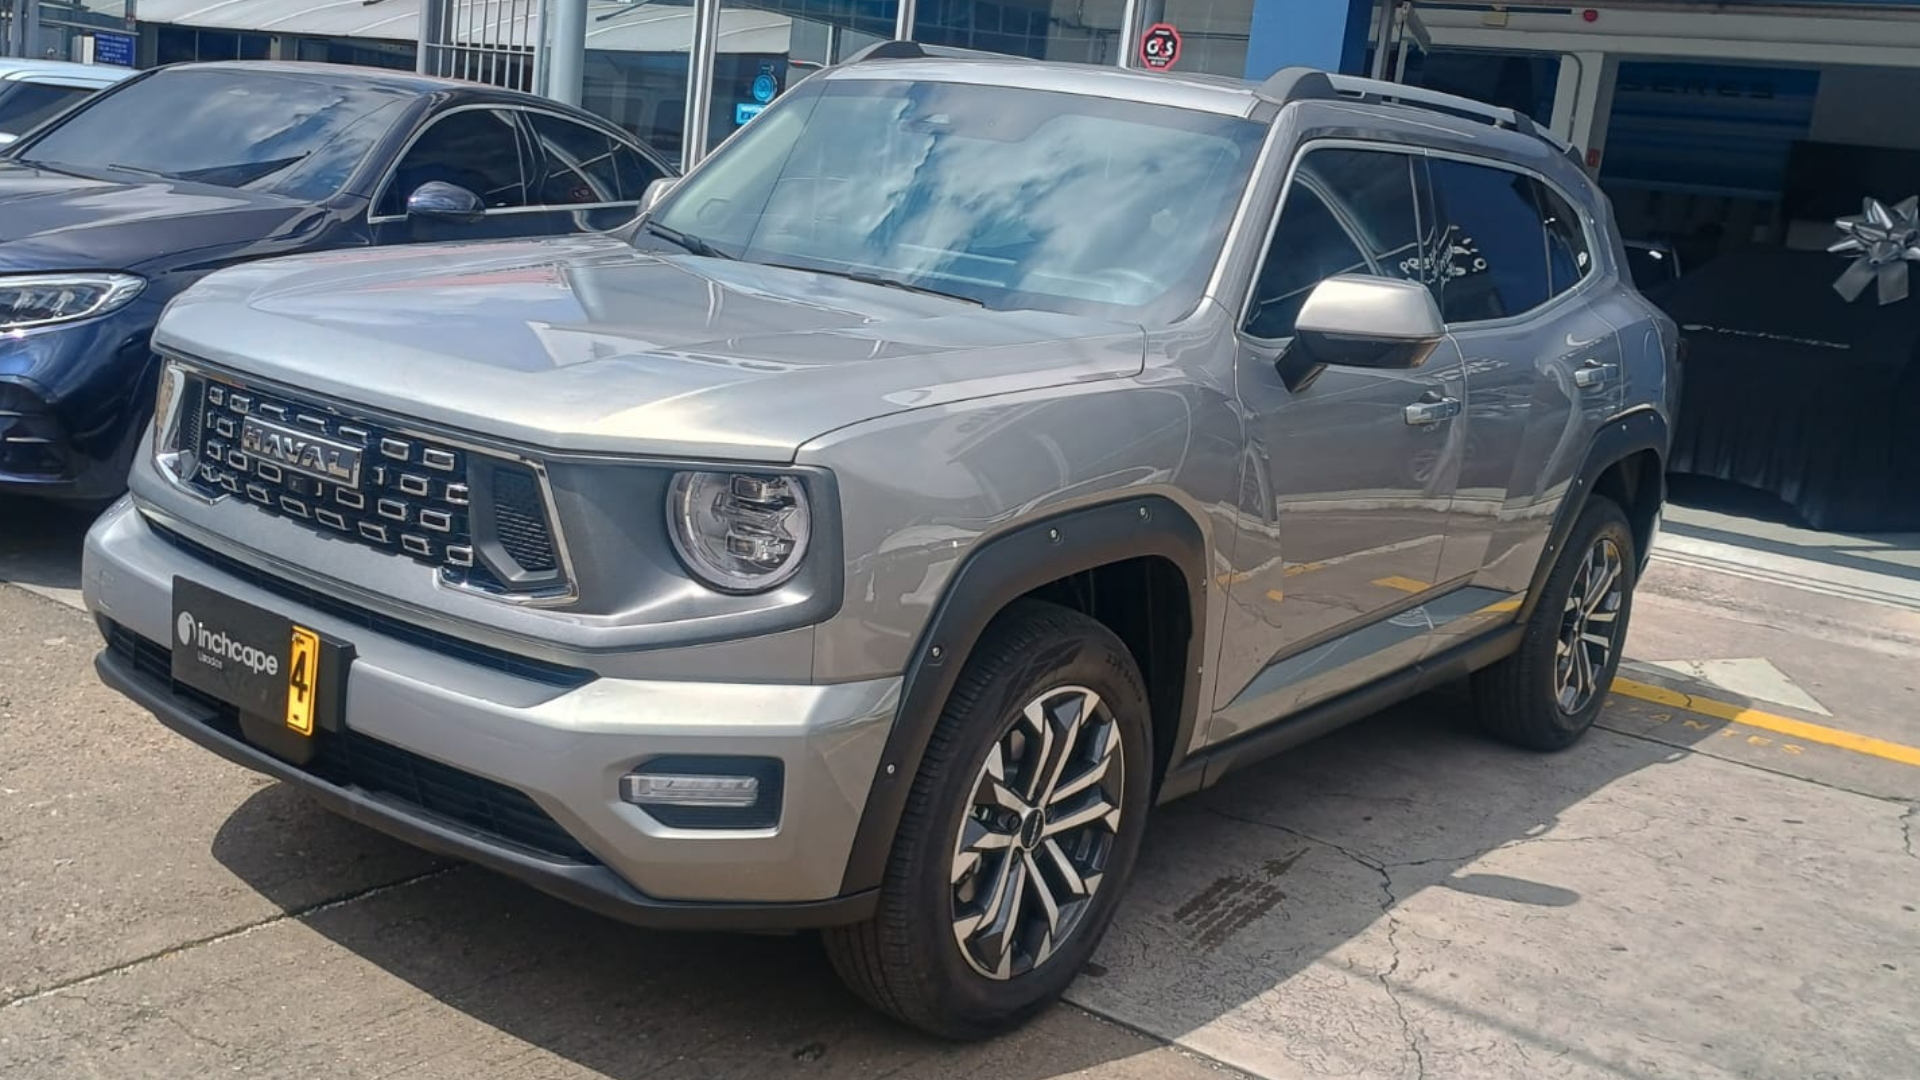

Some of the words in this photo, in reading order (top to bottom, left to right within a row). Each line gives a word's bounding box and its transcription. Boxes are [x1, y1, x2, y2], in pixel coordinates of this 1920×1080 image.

[243, 425, 349, 479] HAVAL
[198, 622, 278, 675] inchcape
[291, 650, 308, 702] 4
